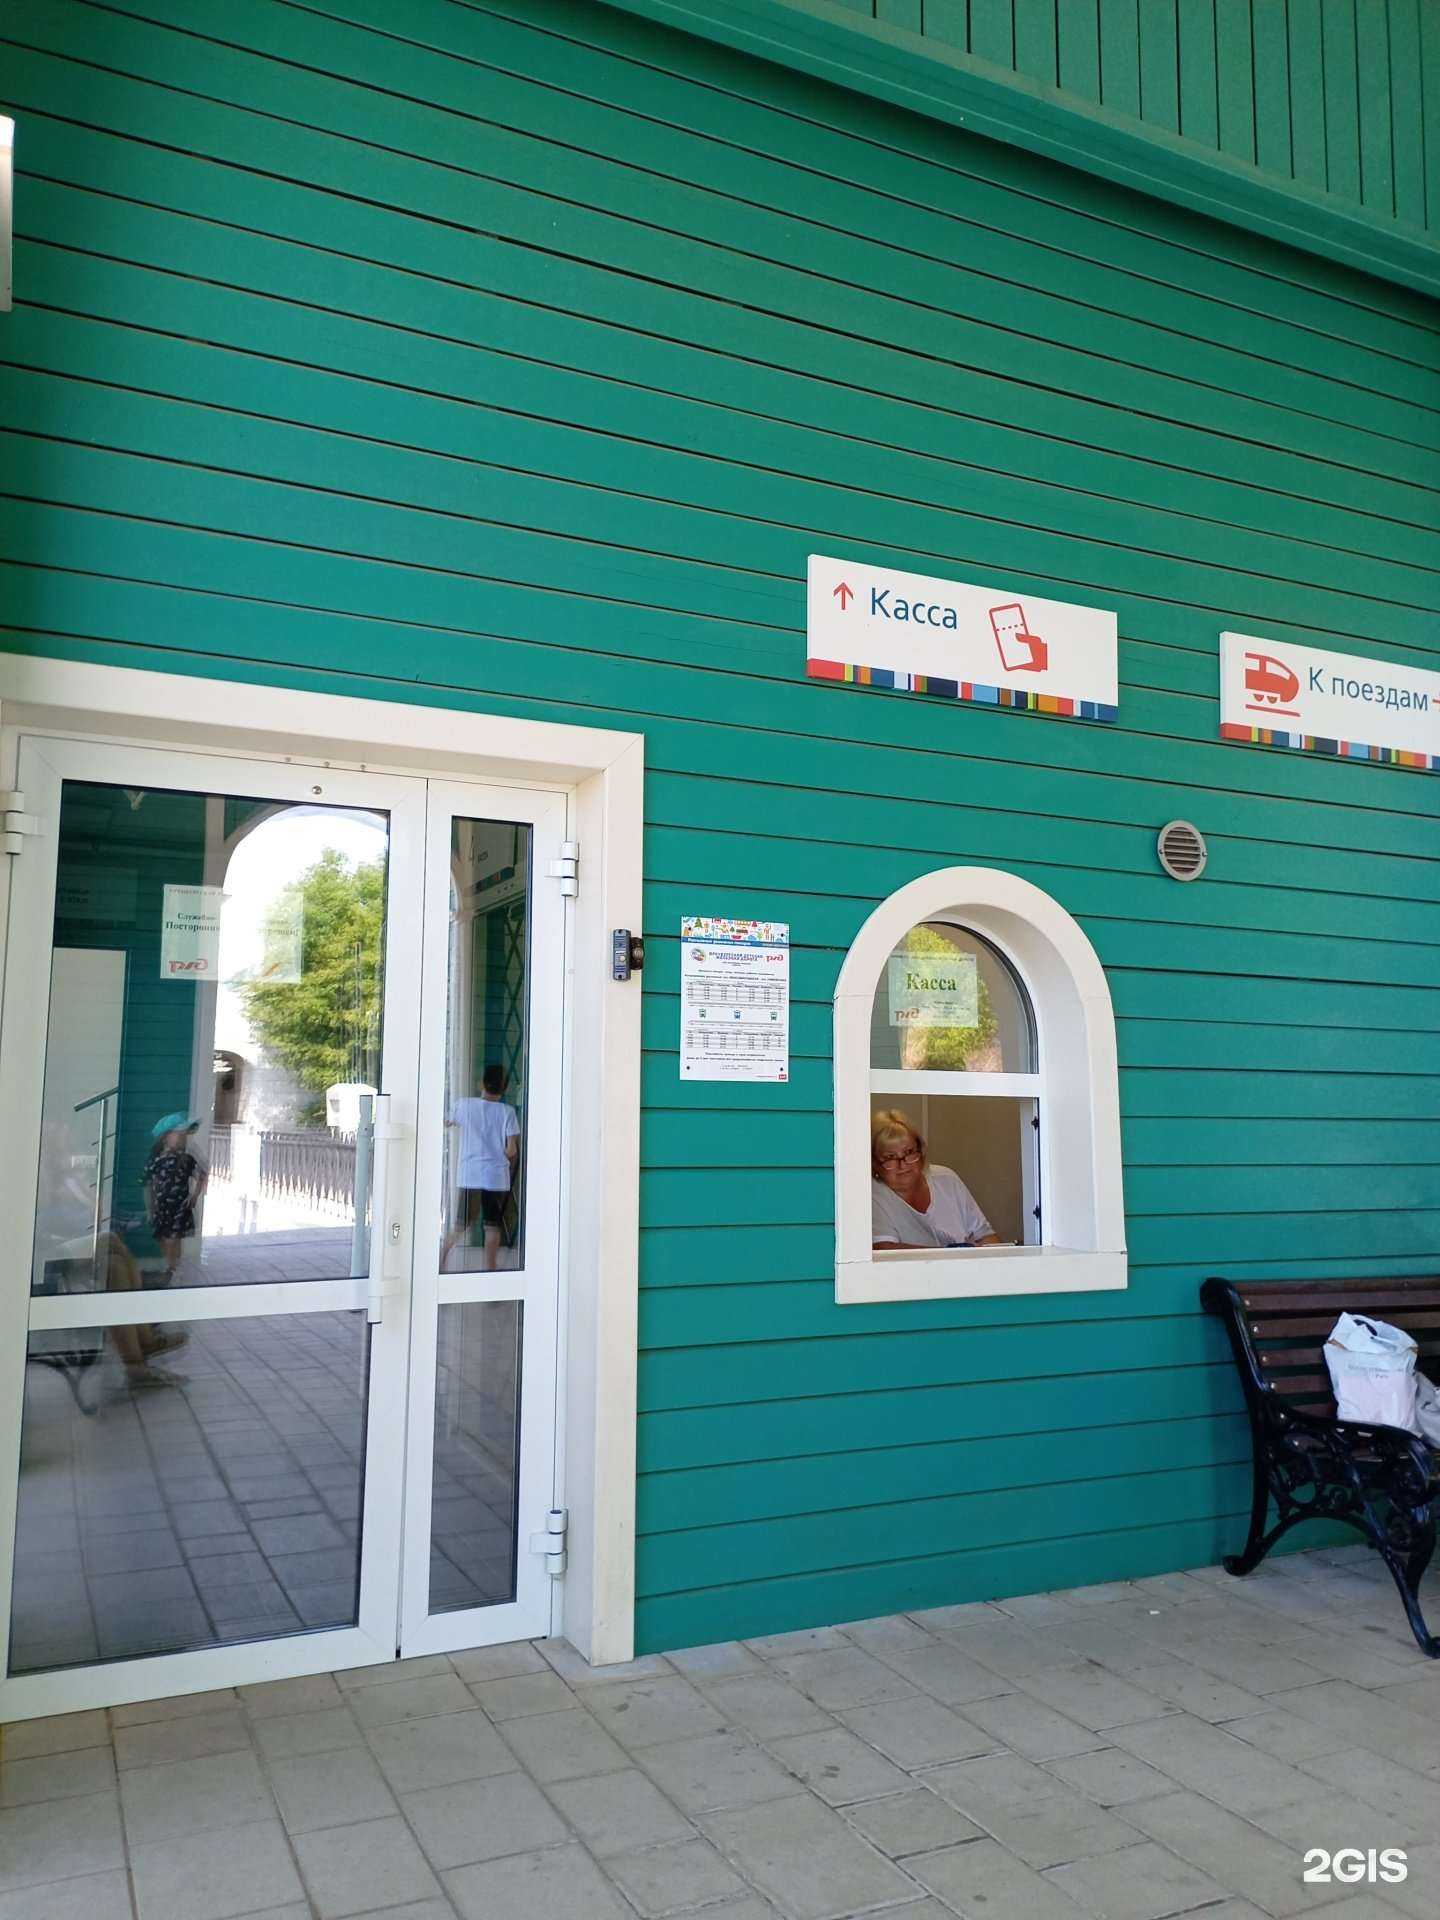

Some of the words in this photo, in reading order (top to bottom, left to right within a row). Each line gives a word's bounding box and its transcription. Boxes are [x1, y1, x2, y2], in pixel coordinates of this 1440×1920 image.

[871, 587, 958, 630] Касса
[1308, 667, 1325, 693] К
[1332, 677, 1429, 711] поездам
[906, 972, 957, 991] Касса
